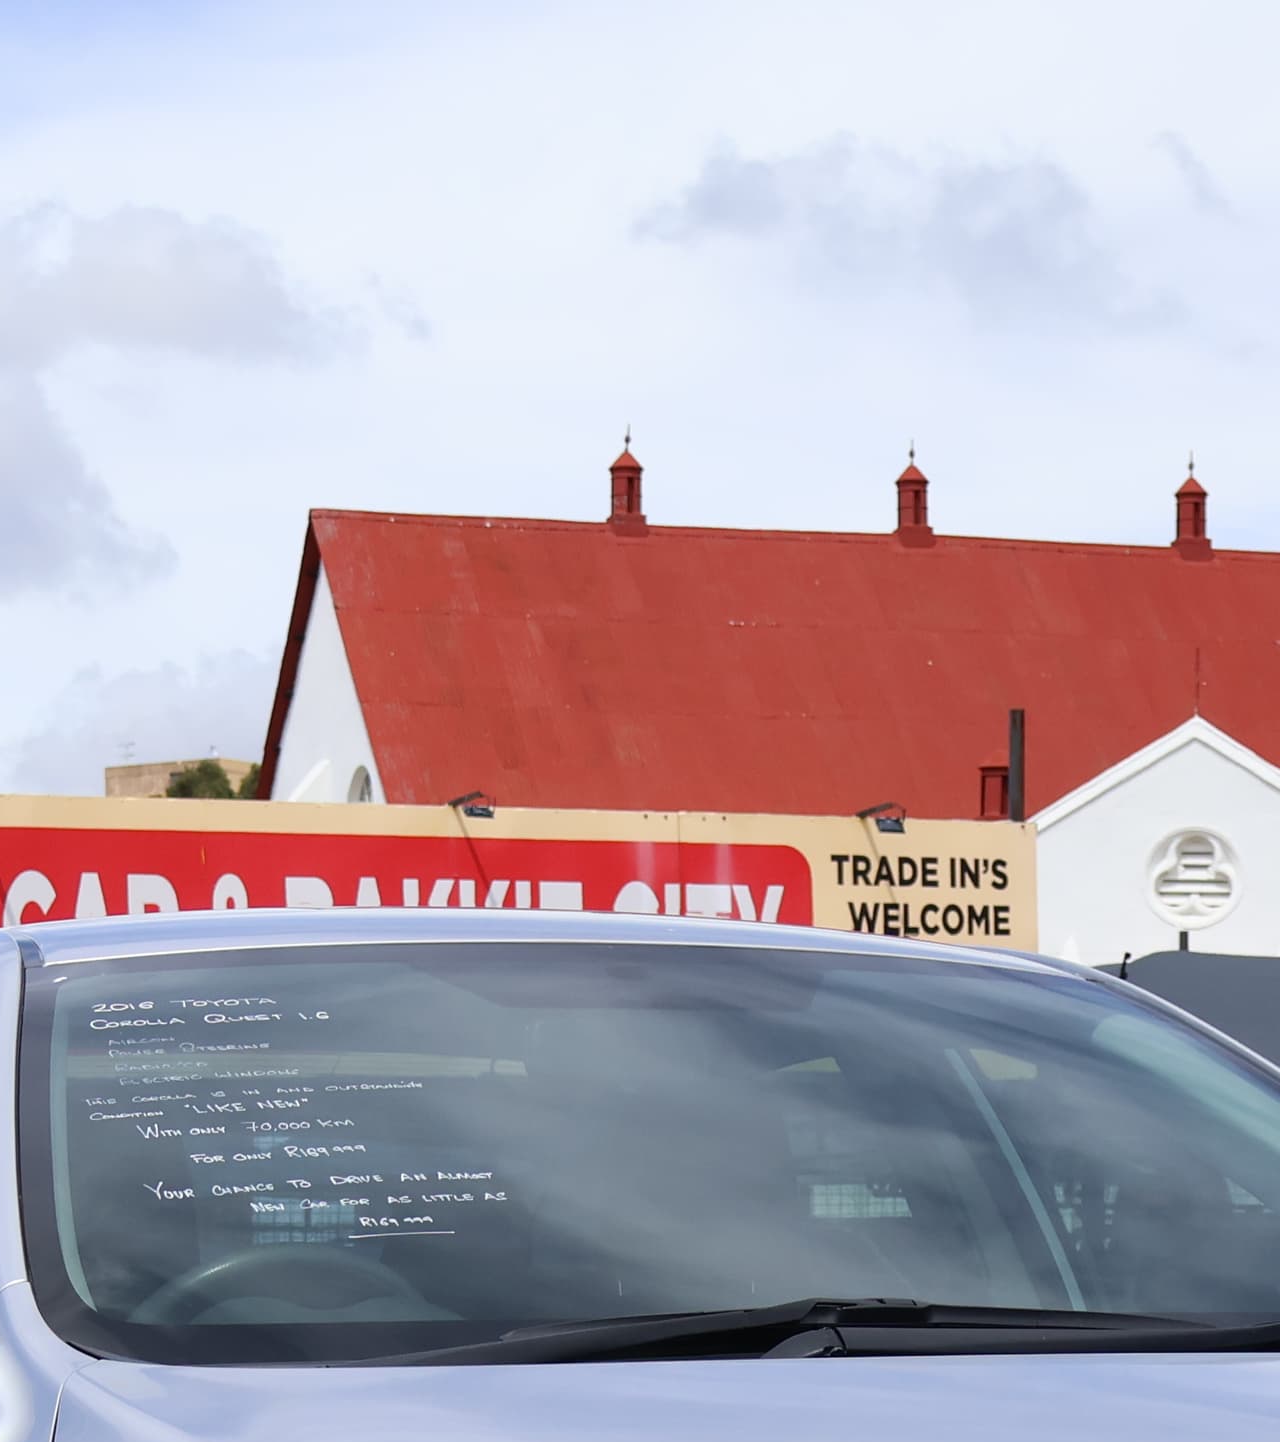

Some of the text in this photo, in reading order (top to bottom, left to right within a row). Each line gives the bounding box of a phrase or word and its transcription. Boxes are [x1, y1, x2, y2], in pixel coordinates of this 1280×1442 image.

[830, 854, 1009, 891] TRADE IN'S
[848, 901, 1010, 937] WELCOME
[91, 997, 277, 1013] 2016 TOYOTA
[89, 1011, 330, 1030] COROLLA QUEST 1.6
[136, 1123, 183, 1139] WITH
[189, 1126, 226, 1136] ONLY
[189, 1153, 226, 1165] FOR
[232, 1152, 272, 1162] ONLY
[143, 1181, 196, 1200] YOUR
[211, 1183, 275, 1197] CHANCE
[286, 1179, 312, 1189] TO
[329, 1174, 384, 1185] DRIVE
[400, 1172, 428, 1183] AN
[339, 1198, 371, 1207] FOR
[387, 1195, 413, 1204] AS
[484, 1191, 508, 1201] AS
